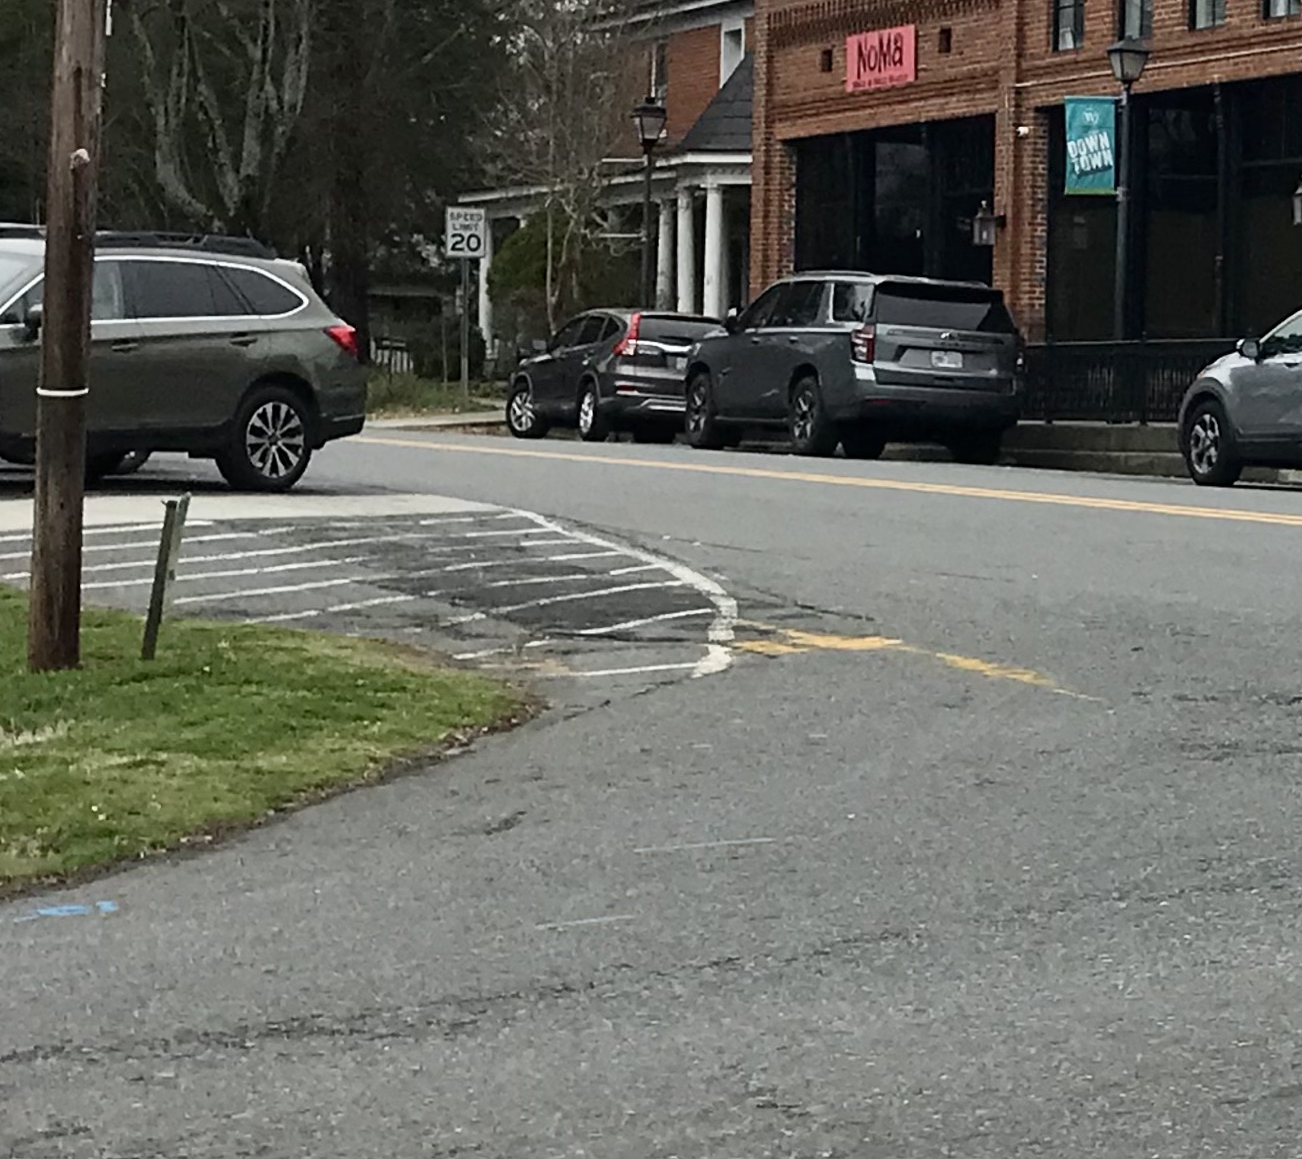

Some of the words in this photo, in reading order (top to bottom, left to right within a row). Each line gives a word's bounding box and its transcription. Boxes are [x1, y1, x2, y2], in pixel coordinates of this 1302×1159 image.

[1067, 131, 1110, 158] DOWN
[1071, 148, 1113, 175] TOWN
[450, 233, 482, 252] 20
